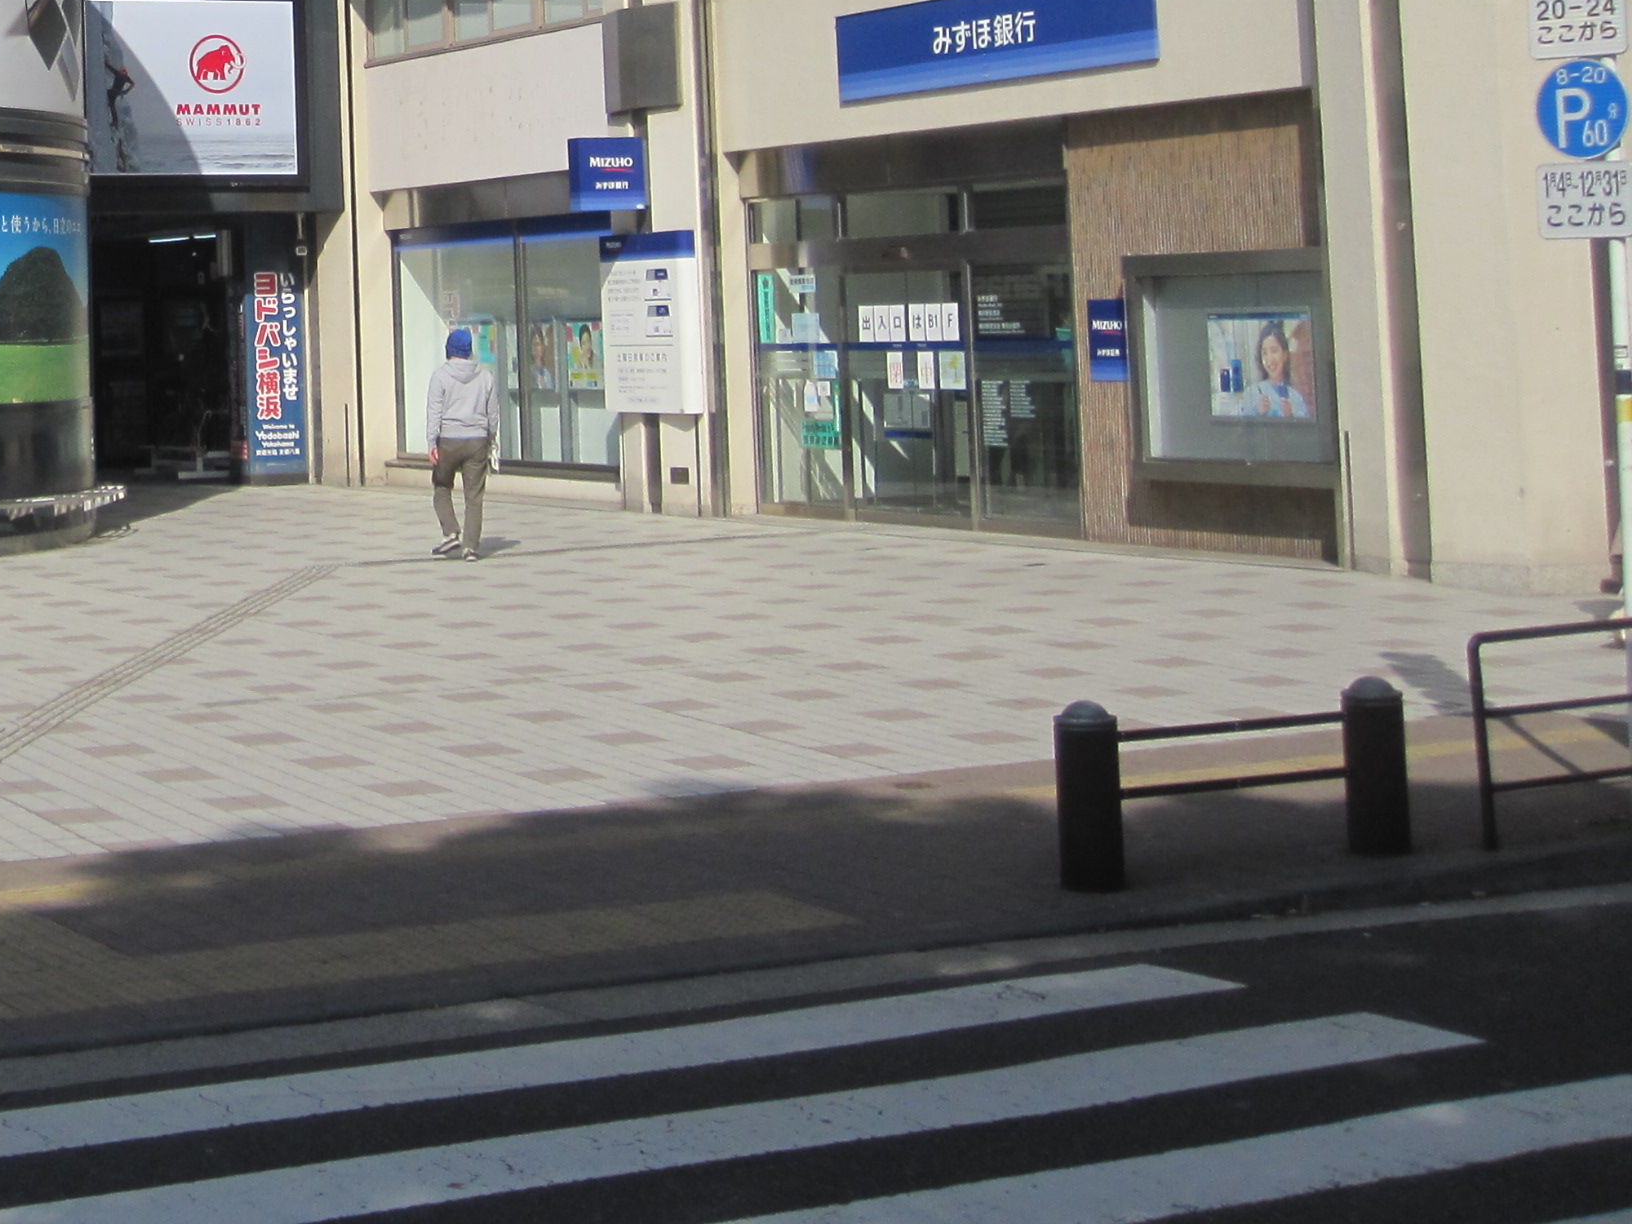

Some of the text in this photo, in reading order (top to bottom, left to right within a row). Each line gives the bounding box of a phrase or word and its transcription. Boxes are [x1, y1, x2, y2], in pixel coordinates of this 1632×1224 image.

[932, 11, 1036, 55] みずほ銀行
[1537, 21, 1618, 45] ここから
[1555, 66, 1607, 85] 8-20
[176, 103, 261, 115] MAMMUT
[1555, 87, 1591, 149] P
[176, 118, 261, 126] SWISS 1862
[1582, 119, 1608, 147] 60
[589, 156, 633, 167] MIZUHO
[1546, 202, 1626, 228] ここから
[279, 273, 299, 401] いらっしゃいませ
[1092, 320, 1123, 330] MIZUHO
[254, 272, 282, 420] ヨドバシ横浜
[255, 430, 300, 441] Yodobashi
